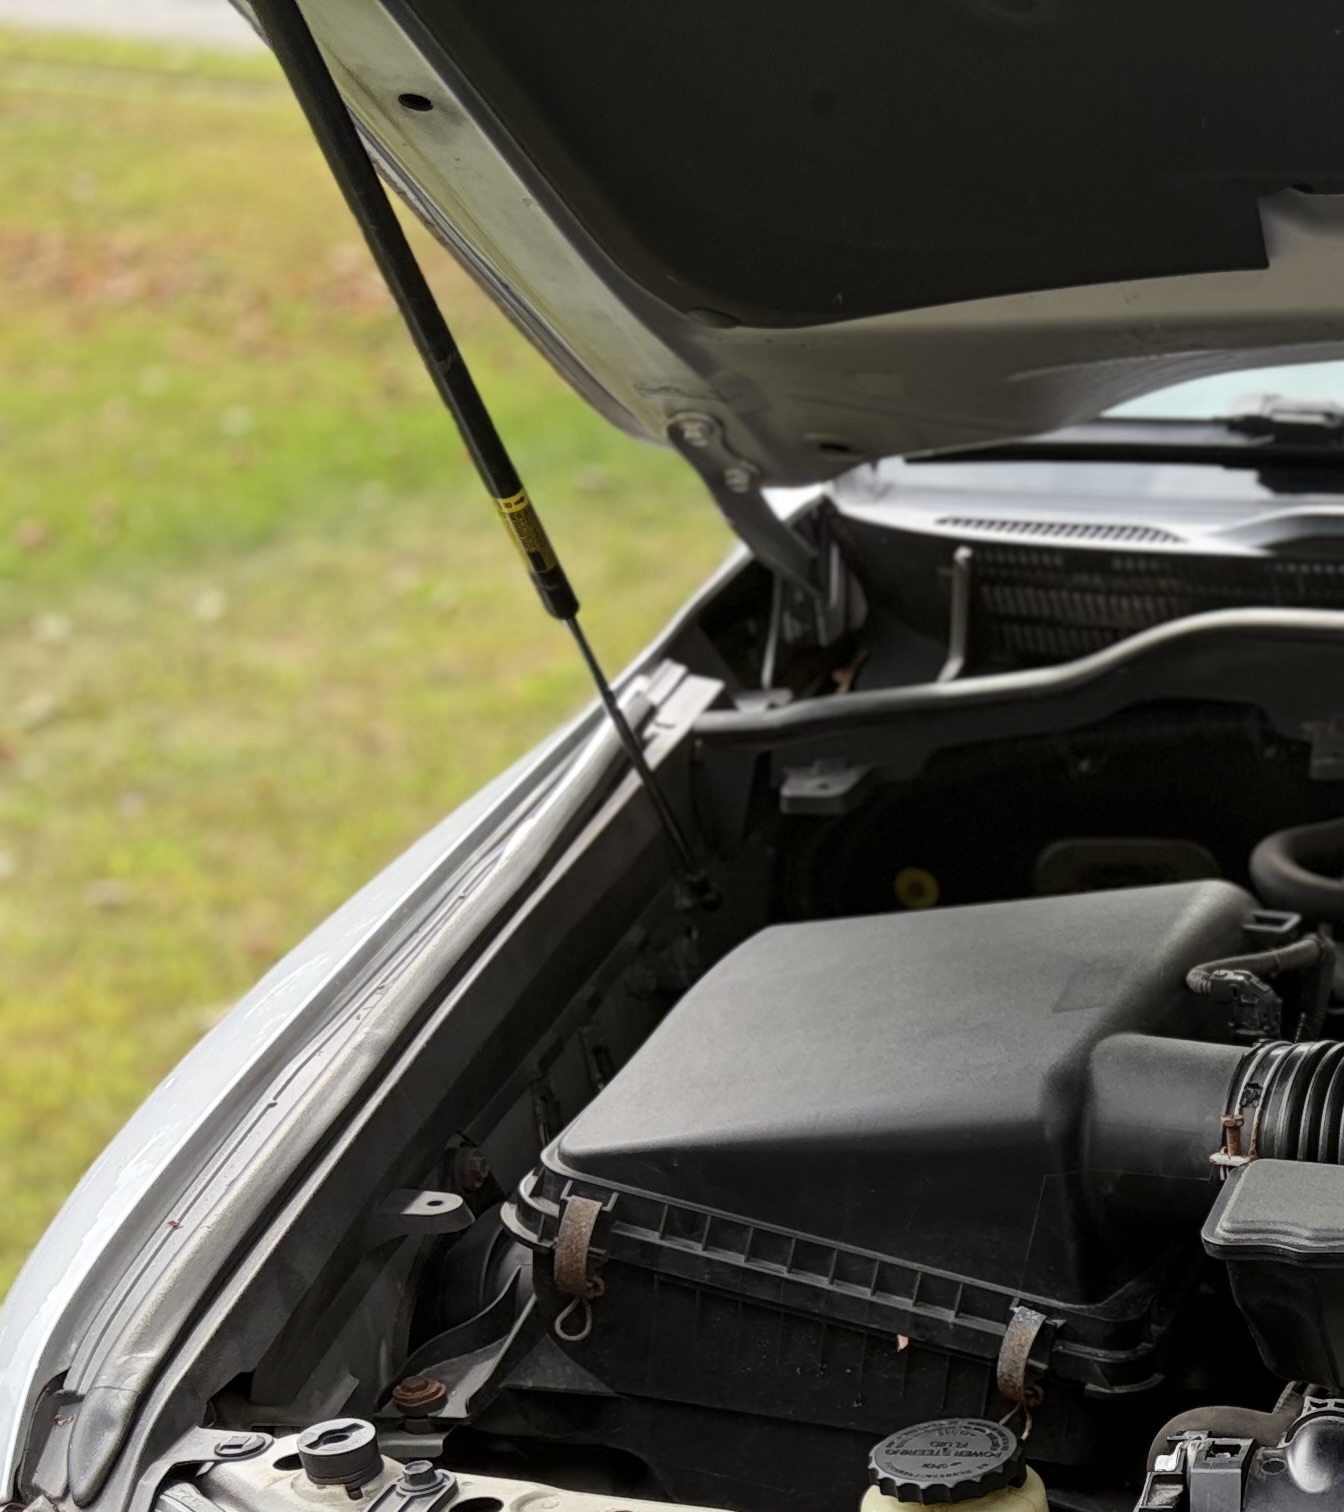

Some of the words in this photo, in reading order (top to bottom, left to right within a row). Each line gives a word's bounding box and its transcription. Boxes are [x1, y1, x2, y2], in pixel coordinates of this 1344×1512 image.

[929, 1441, 969, 1449] FLUID
[884, 1448, 952, 1457] STEERING
[953, 1449, 1003, 1459] POWER
